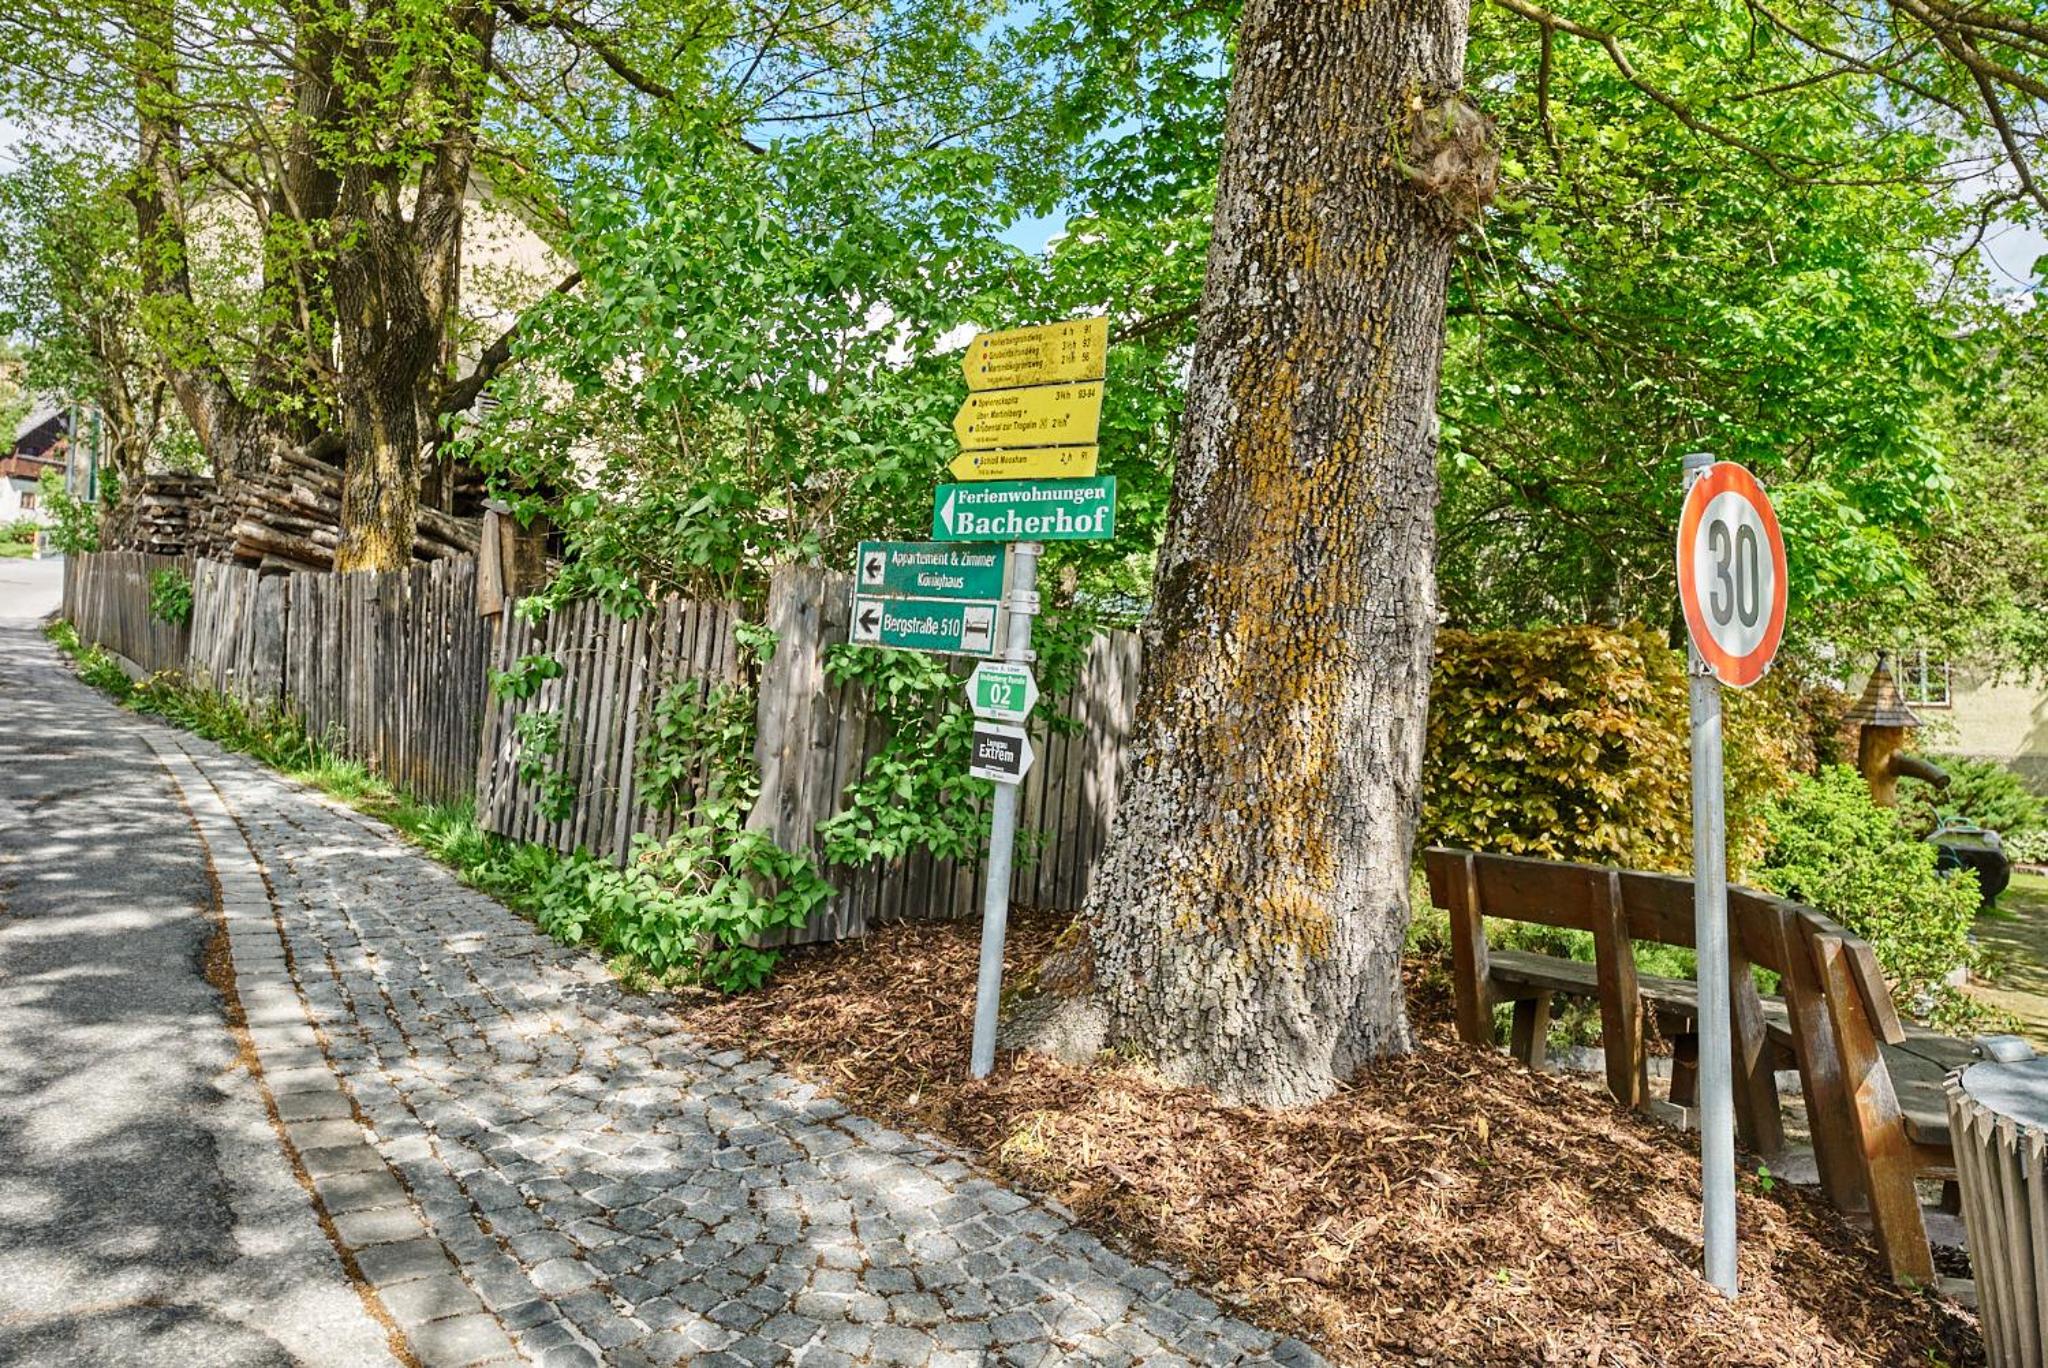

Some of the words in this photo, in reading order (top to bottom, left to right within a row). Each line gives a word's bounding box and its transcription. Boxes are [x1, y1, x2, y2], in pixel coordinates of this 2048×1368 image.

[958, 486, 1106, 506] Ferienwohnungen
[956, 506, 1109, 535] Bacherhof
[891, 550, 948, 568] Appartement
[950, 551, 960, 566] &
[960, 551, 998, 567] Zimmer
[1707, 518, 1760, 629] 30
[883, 614, 939, 638] Bergstraße
[940, 616, 961, 638] 510
[990, 683, 1012, 705] 02
[979, 743, 1014, 763] Extrem
